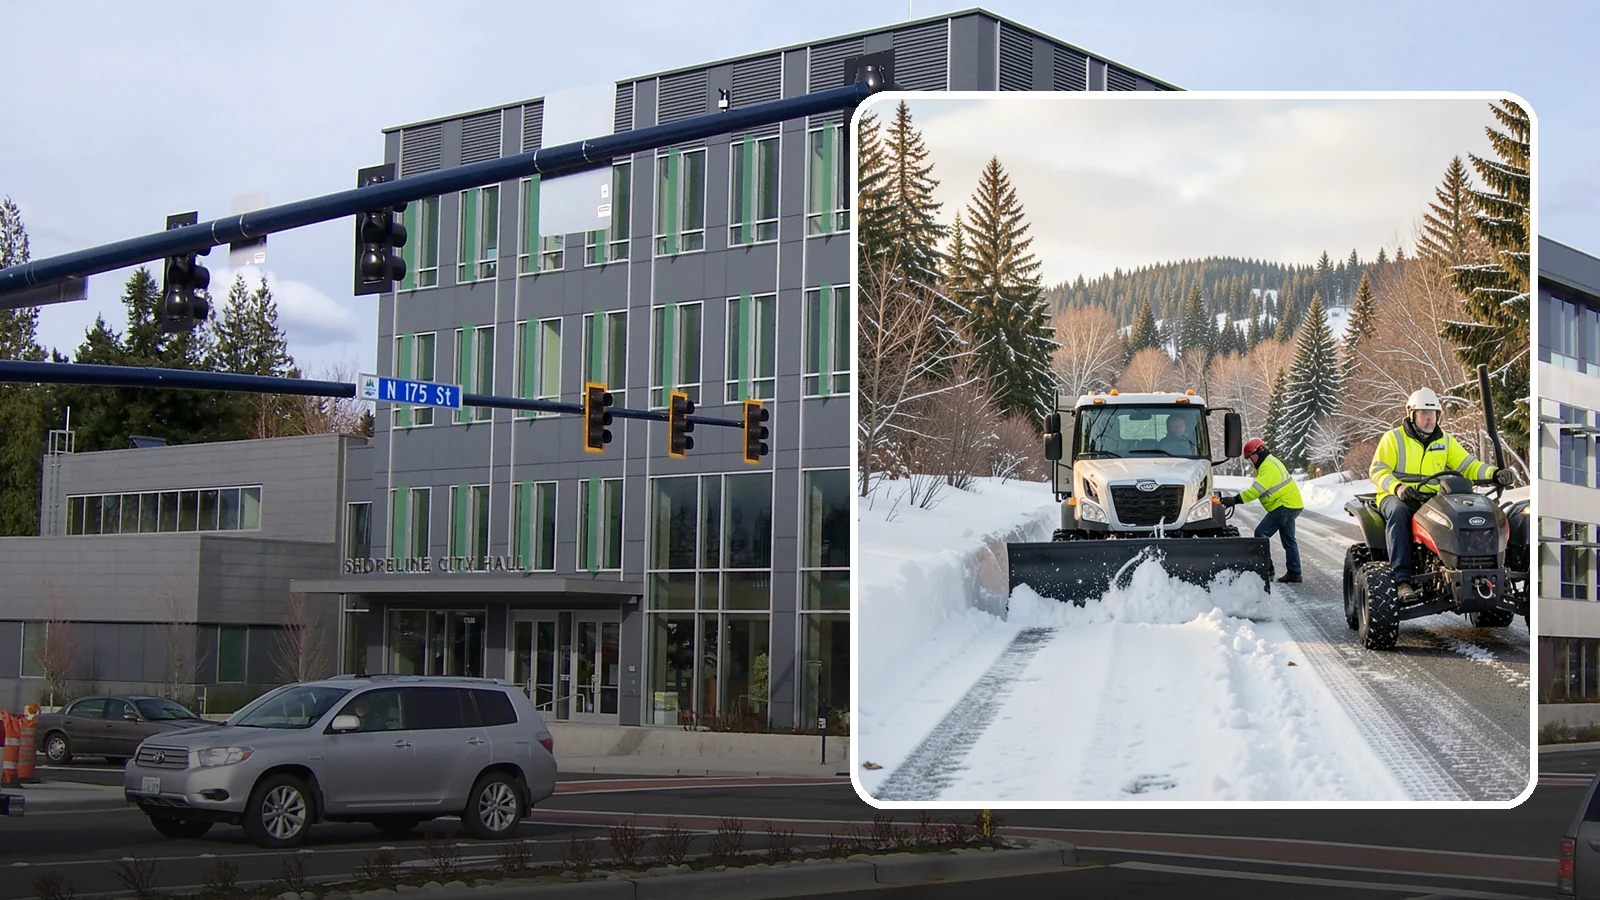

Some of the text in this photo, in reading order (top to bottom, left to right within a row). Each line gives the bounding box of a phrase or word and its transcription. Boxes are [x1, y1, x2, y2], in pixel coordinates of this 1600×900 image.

[387, 380, 451, 406] N 175 St
[343, 556, 525, 574] SHORELINE CITY HALL
